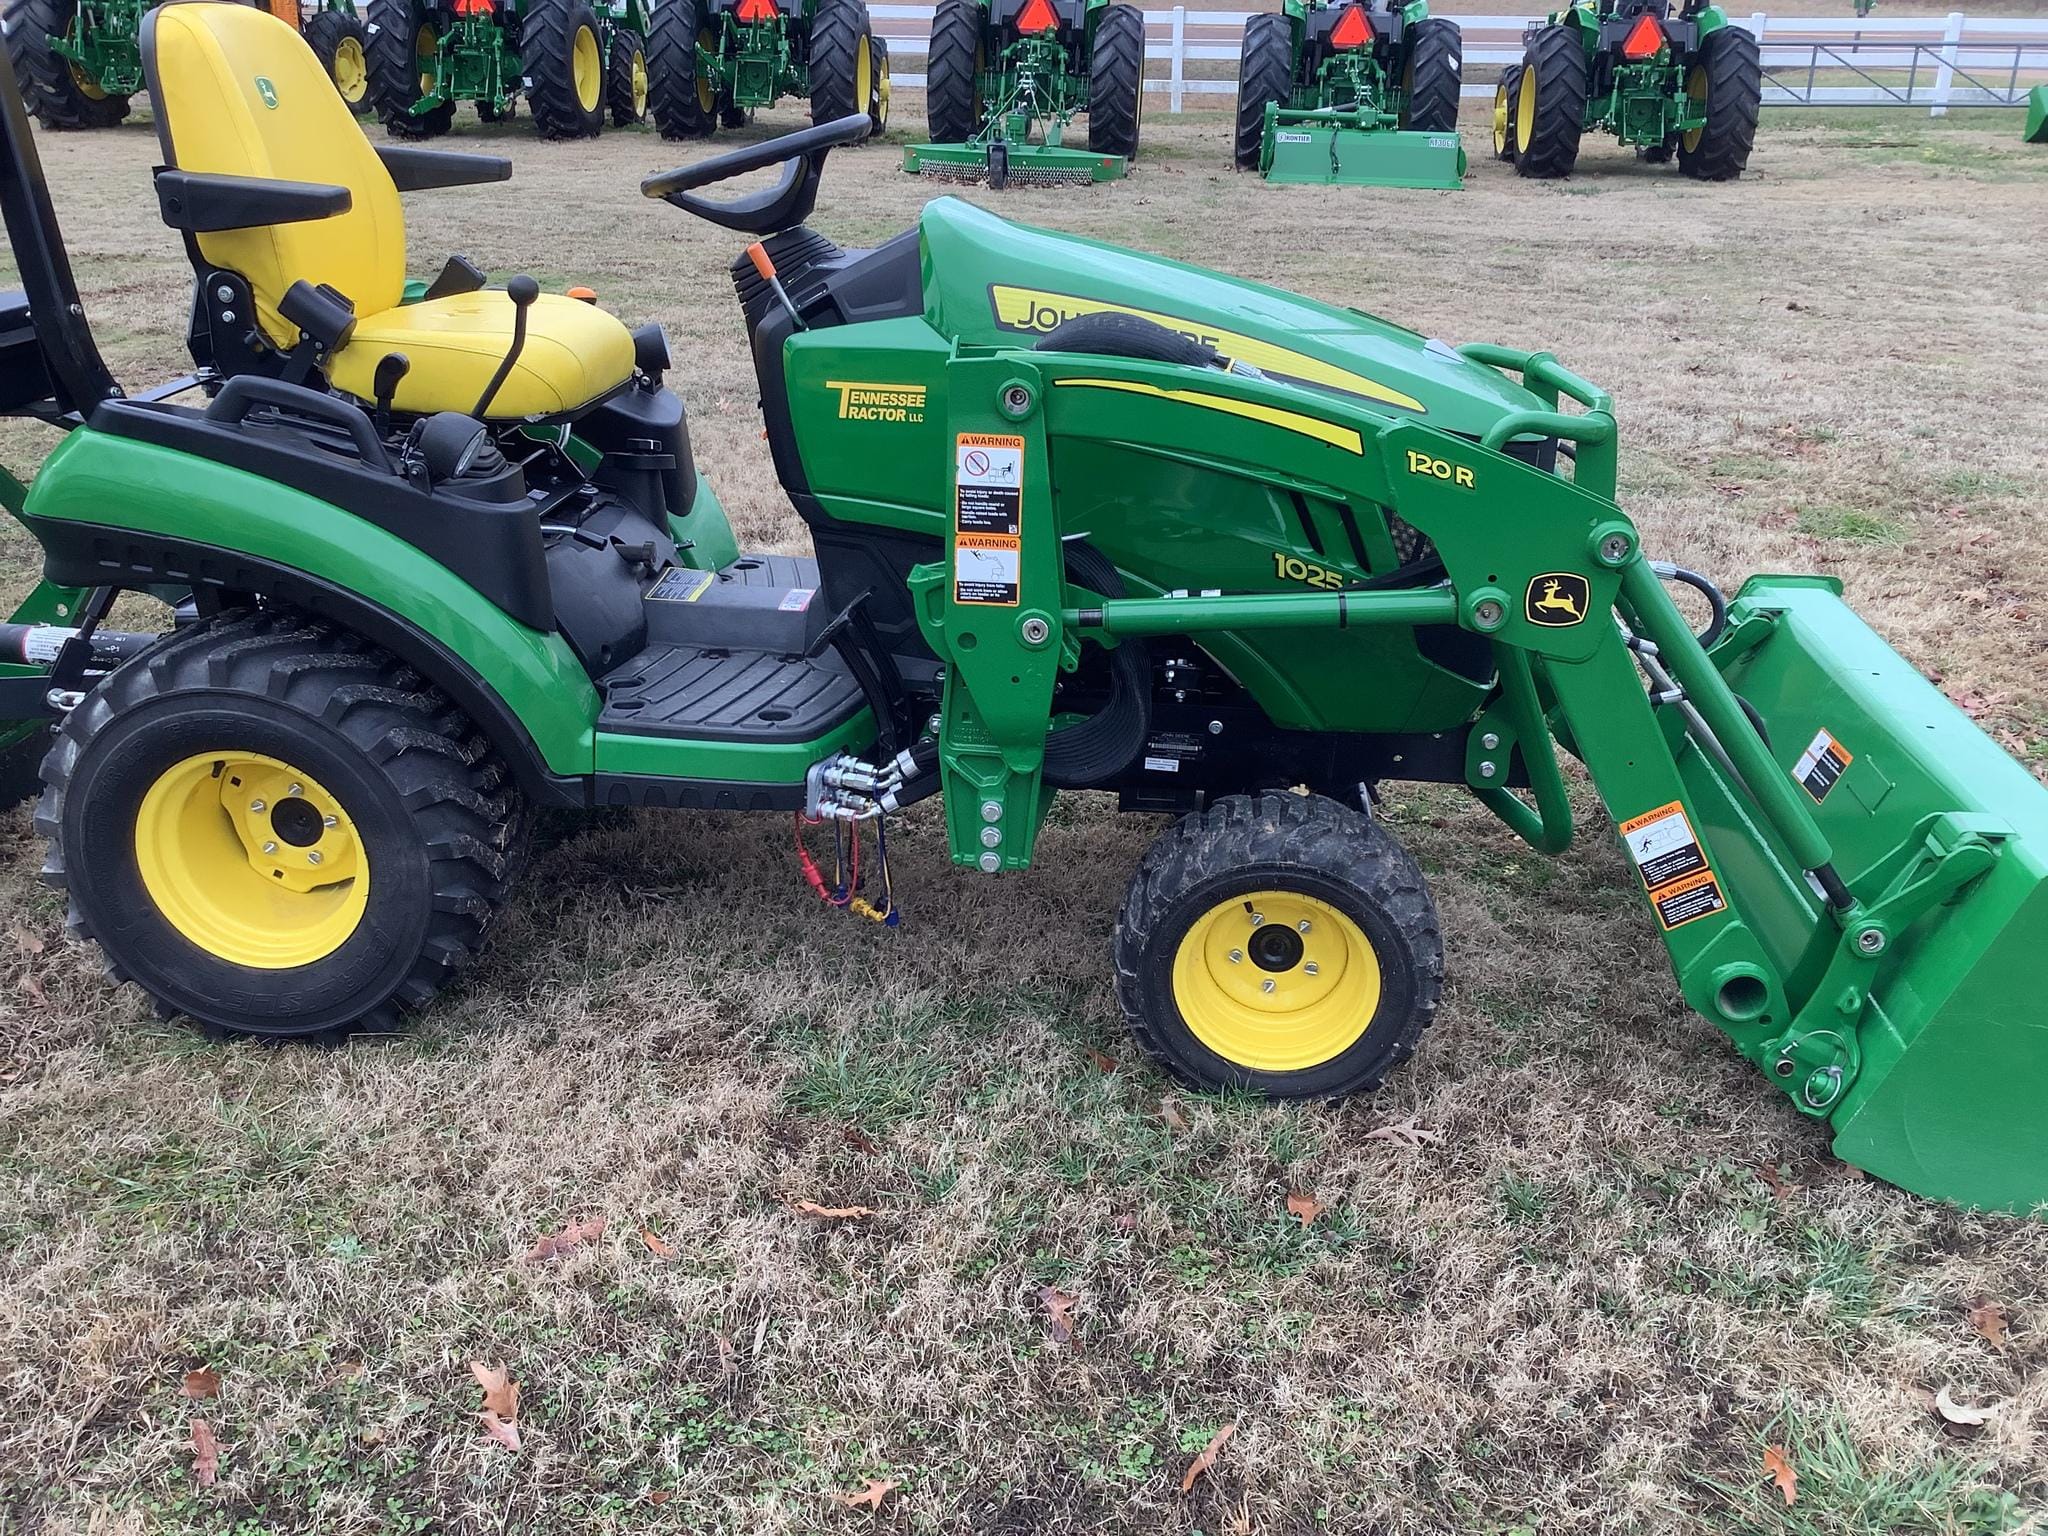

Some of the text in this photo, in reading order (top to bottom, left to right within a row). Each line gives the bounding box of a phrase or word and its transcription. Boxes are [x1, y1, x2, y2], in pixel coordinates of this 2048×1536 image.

[826, 381, 926, 416] TENNESSEE
[908, 413, 924, 423] LLC
[970, 437, 1020, 446] WARNING
[1407, 450, 1474, 488] 120 R
[970, 539, 1017, 548] WARNING
[1635, 806, 1675, 827] WARNING
[1668, 877, 1708, 894] WARNING
